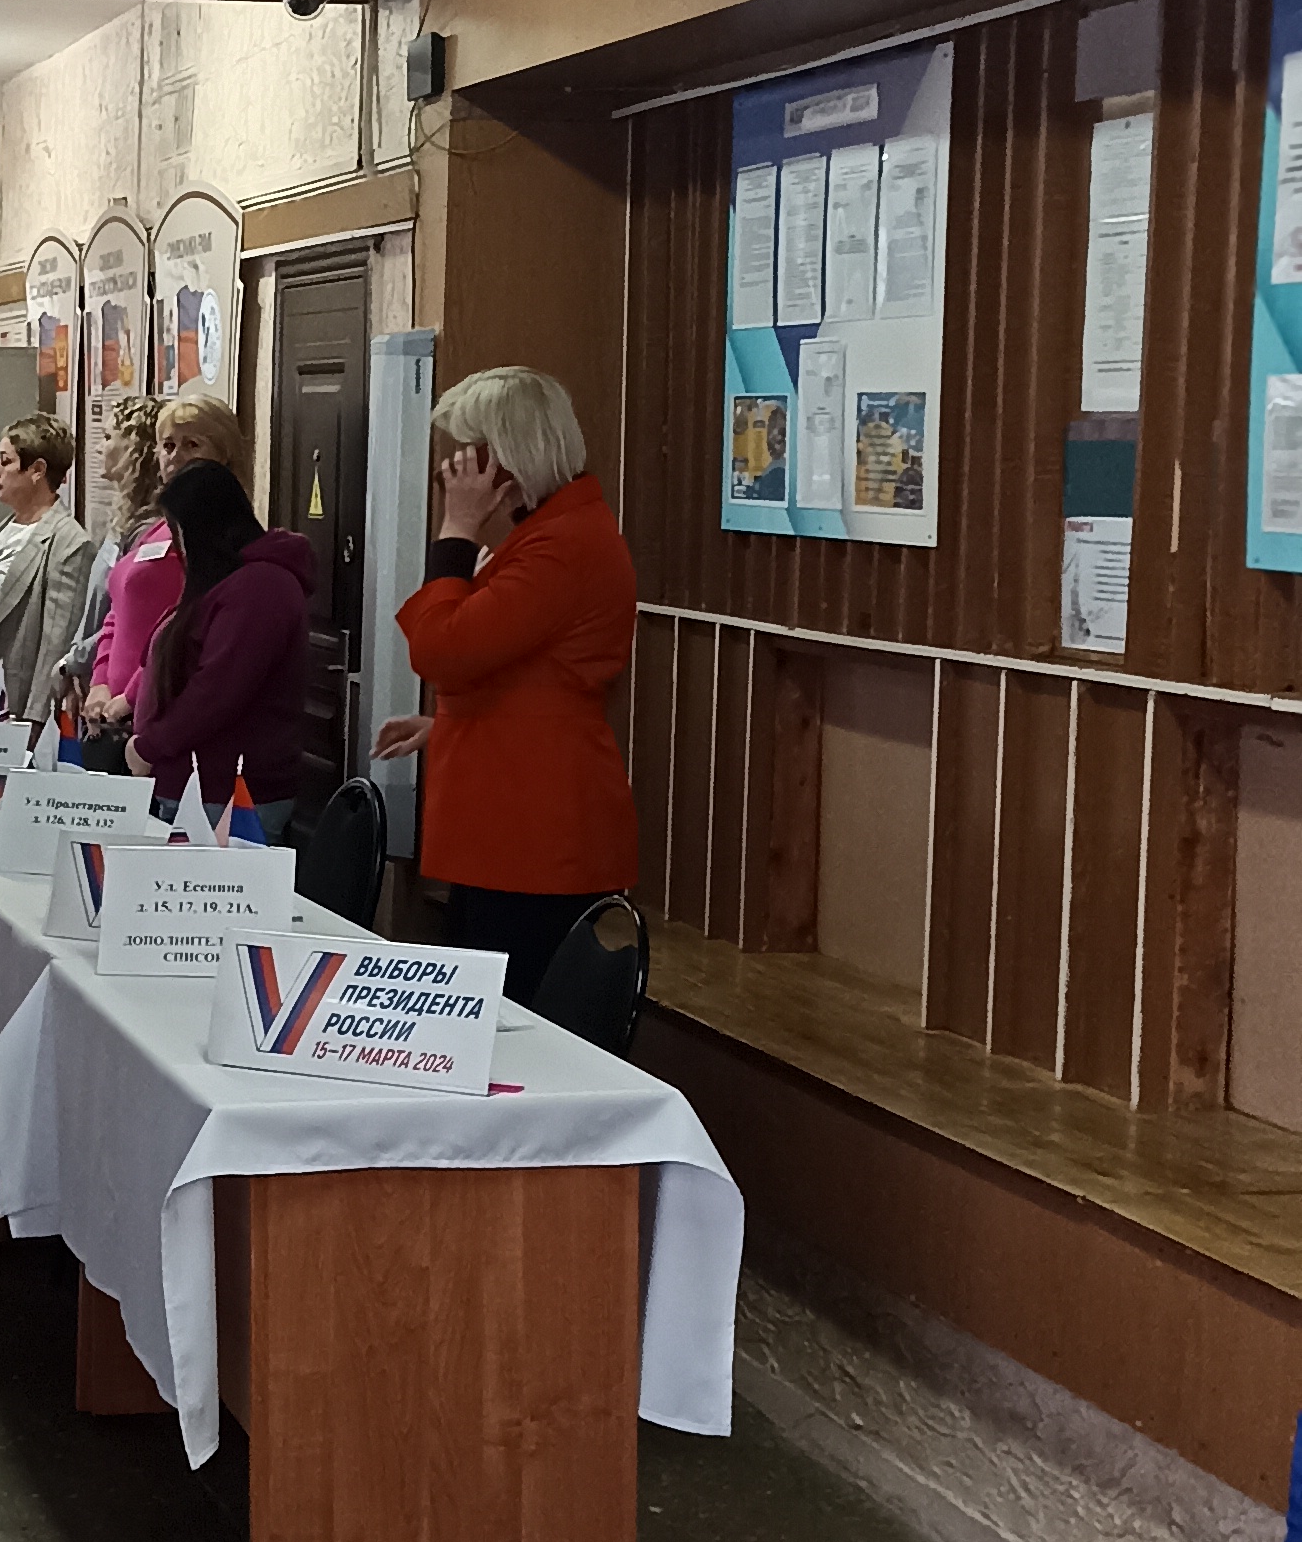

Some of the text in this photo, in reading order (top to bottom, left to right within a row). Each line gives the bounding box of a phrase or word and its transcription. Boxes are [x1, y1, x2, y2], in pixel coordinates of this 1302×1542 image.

[46, 797, 127, 813] Пролетарская
[96, 817, 115, 828] 132
[154, 880, 244, 894] Ул. Есенина
[353, 955, 459, 986] ВЫБОРЫ
[338, 984, 486, 1020] ПРЕЗИДЕНТА
[322, 1012, 417, 1043] РОССИИ
[355, 1045, 414, 1070] МАРТА
[412, 1052, 455, 1074] 2024
